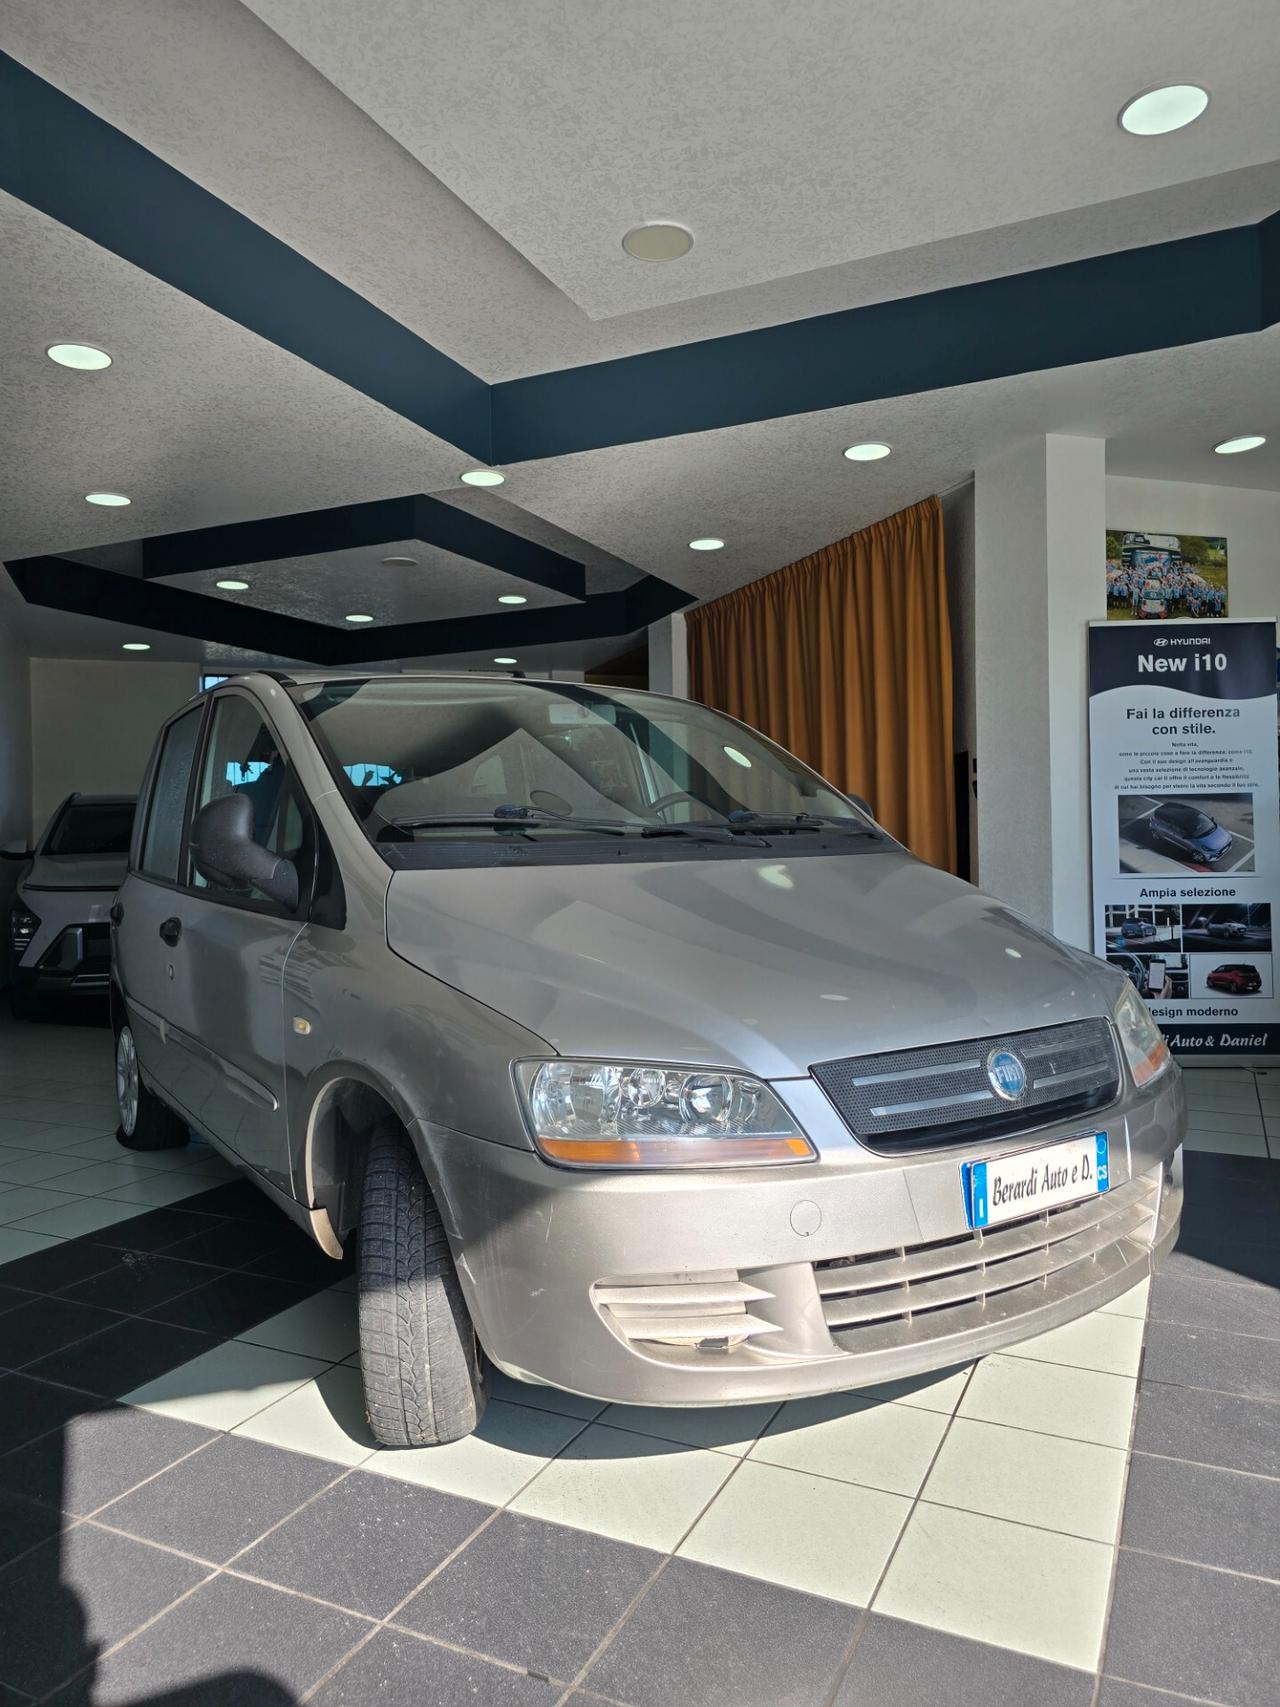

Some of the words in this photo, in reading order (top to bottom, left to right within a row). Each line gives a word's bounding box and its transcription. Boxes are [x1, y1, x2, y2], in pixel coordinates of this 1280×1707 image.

[1170, 638, 1211, 646] HYUNDAI
[1137, 654, 1187, 673] New
[1194, 652, 1228, 672] i10
[1126, 708, 1148, 720] Fai
[1152, 708, 1165, 719] la
[1169, 706, 1241, 719] differenza
[1152, 725, 1178, 735] con
[1182, 722, 1216, 735] stile.
[1140, 888, 1177, 900] Ampia
[1180, 887, 1236, 898] selezione
[1186, 1006, 1238, 1017] moderno
[1170, 1034, 1204, 1047] Auto
[1204, 1035, 1214, 1047] &
[1219, 1032, 1268, 1047] Daniel
[1098, 1164, 1107, 1180] CS
[992, 1166, 1038, 1206] Berardi
[1041, 1163, 1068, 1192] Auto
[1072, 1166, 1078, 1184] e
[1082, 1154, 1093, 1181] D.
